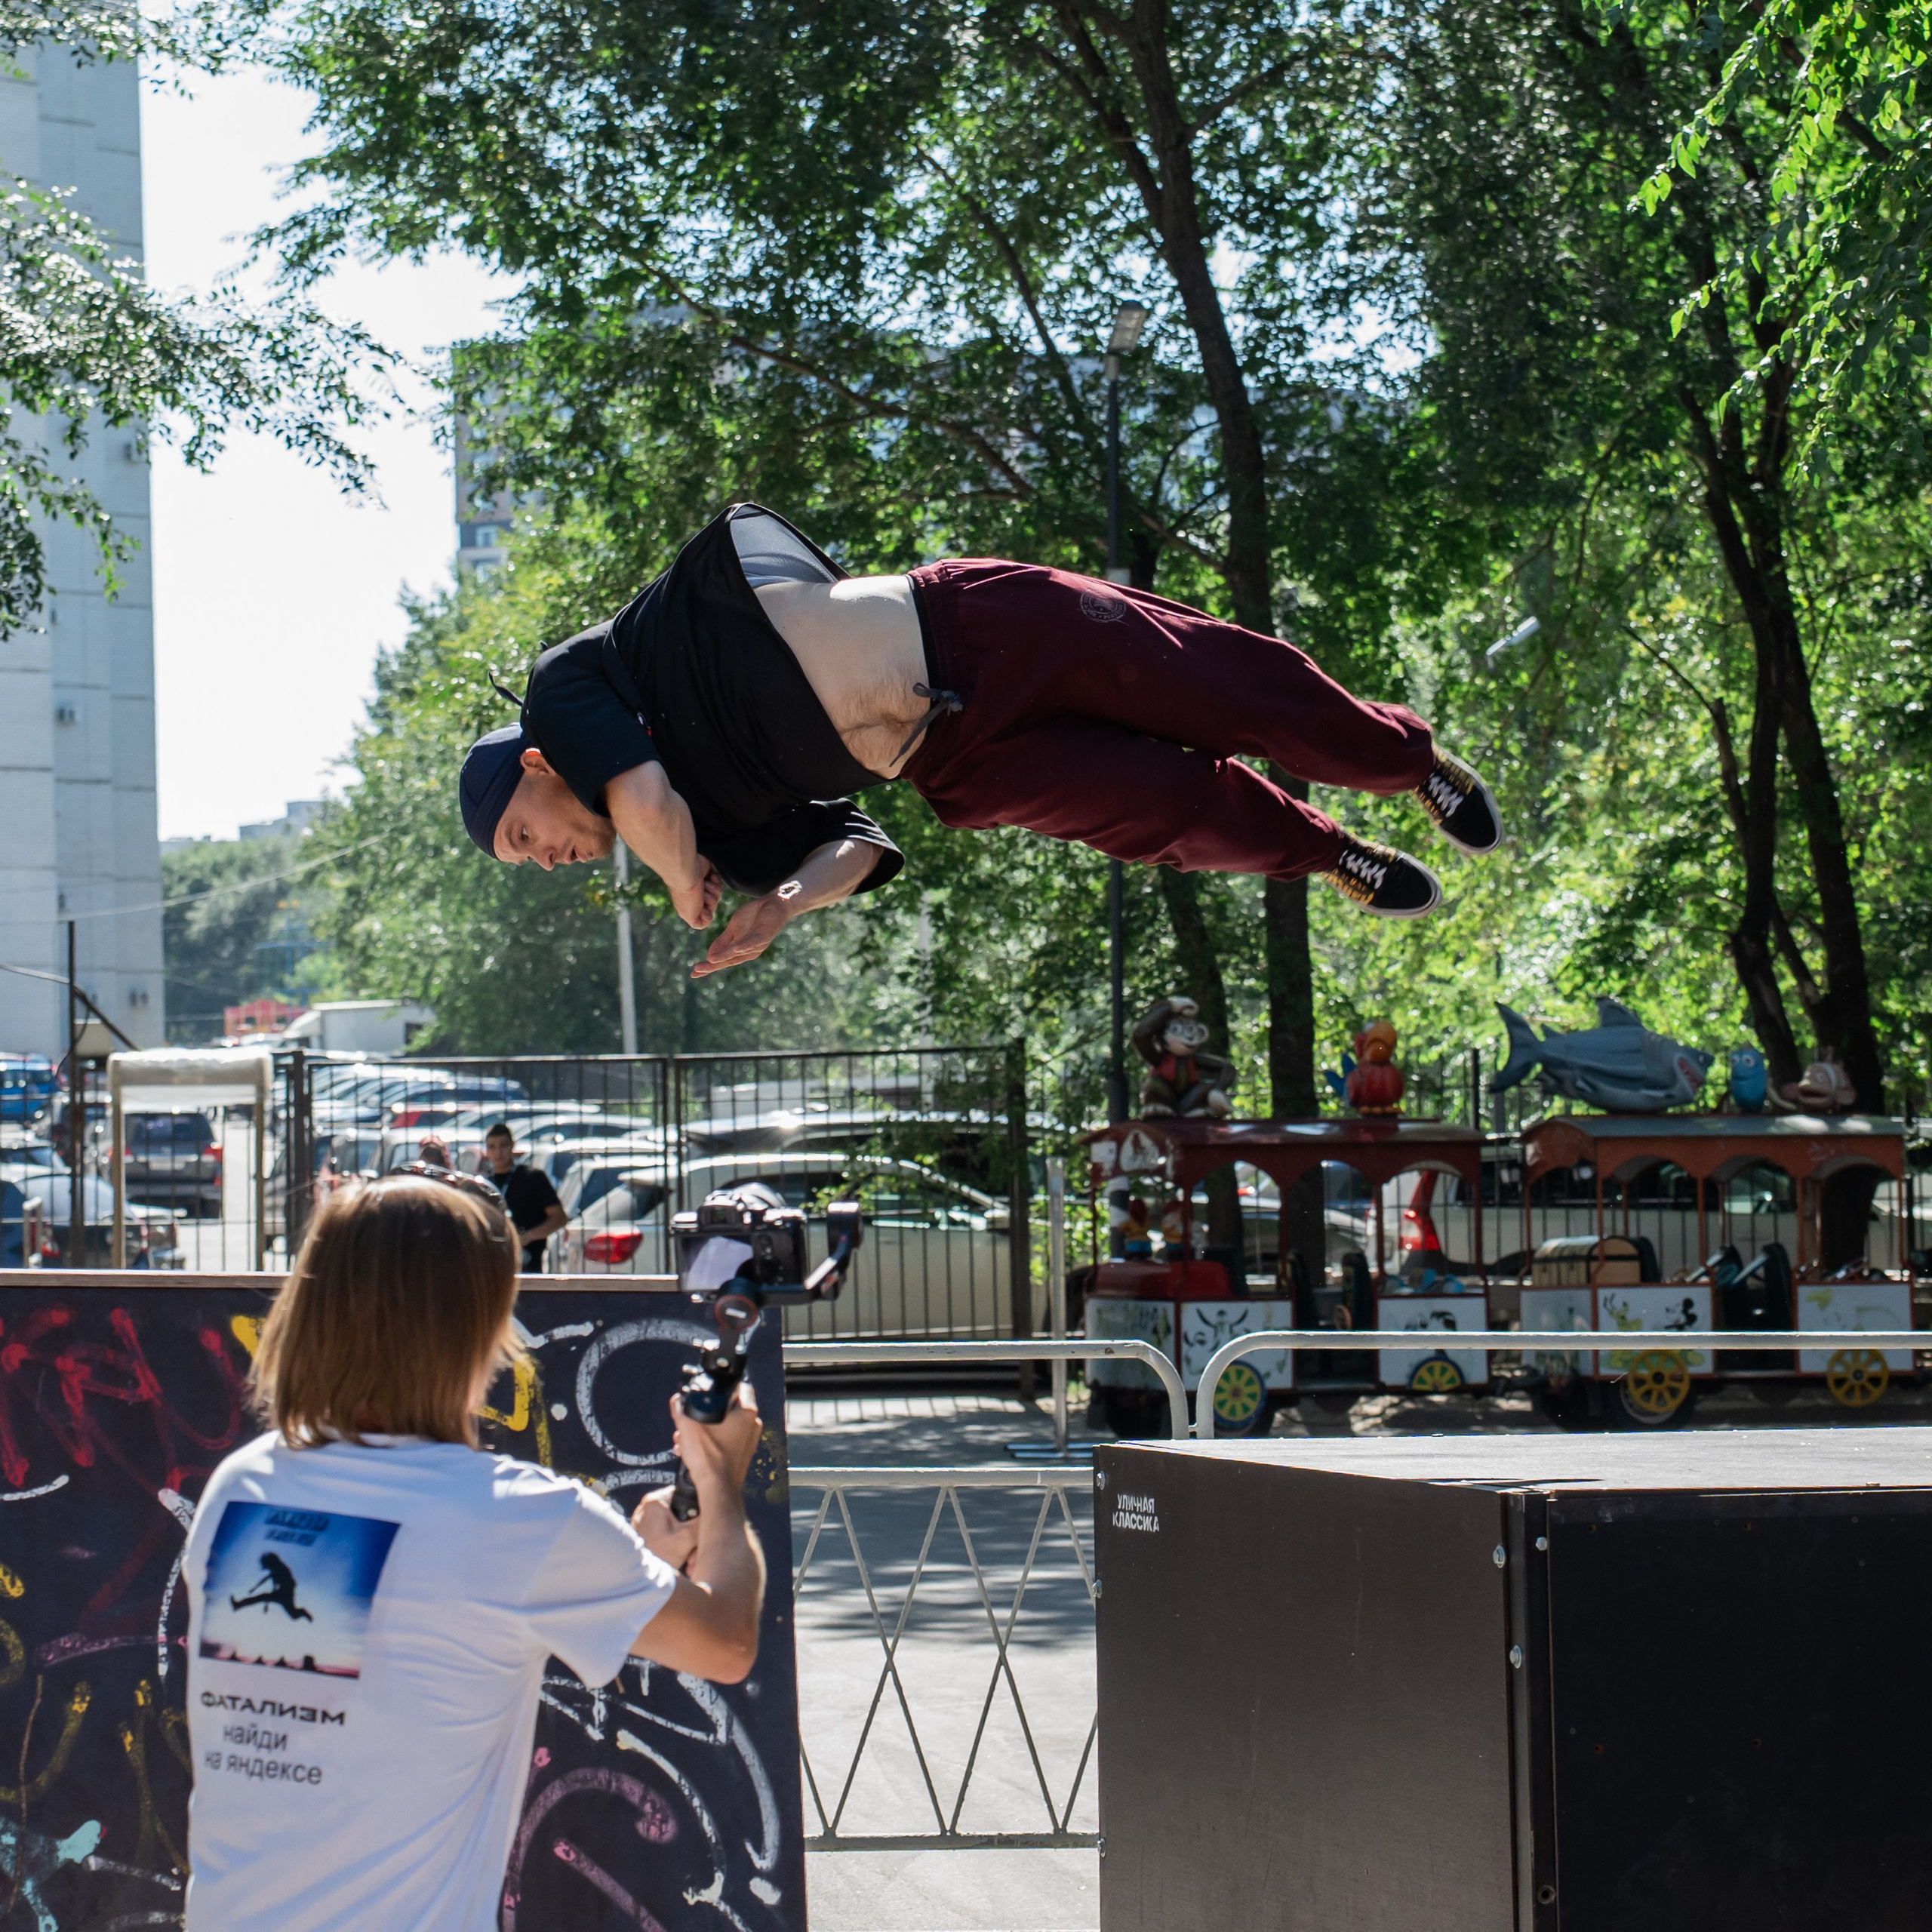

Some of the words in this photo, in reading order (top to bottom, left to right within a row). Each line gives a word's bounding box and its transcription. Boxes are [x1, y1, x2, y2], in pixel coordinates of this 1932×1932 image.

[1117, 1494, 1155, 1514] УЛИЧНАЯ
[1112, 1511, 1160, 1533] КЛАССИКА
[200, 1690, 346, 1726] ФАТАЛИЗМ
[223, 1723, 288, 1752] найди
[205, 1751, 222, 1770] на
[226, 1754, 322, 1785] яндексе
